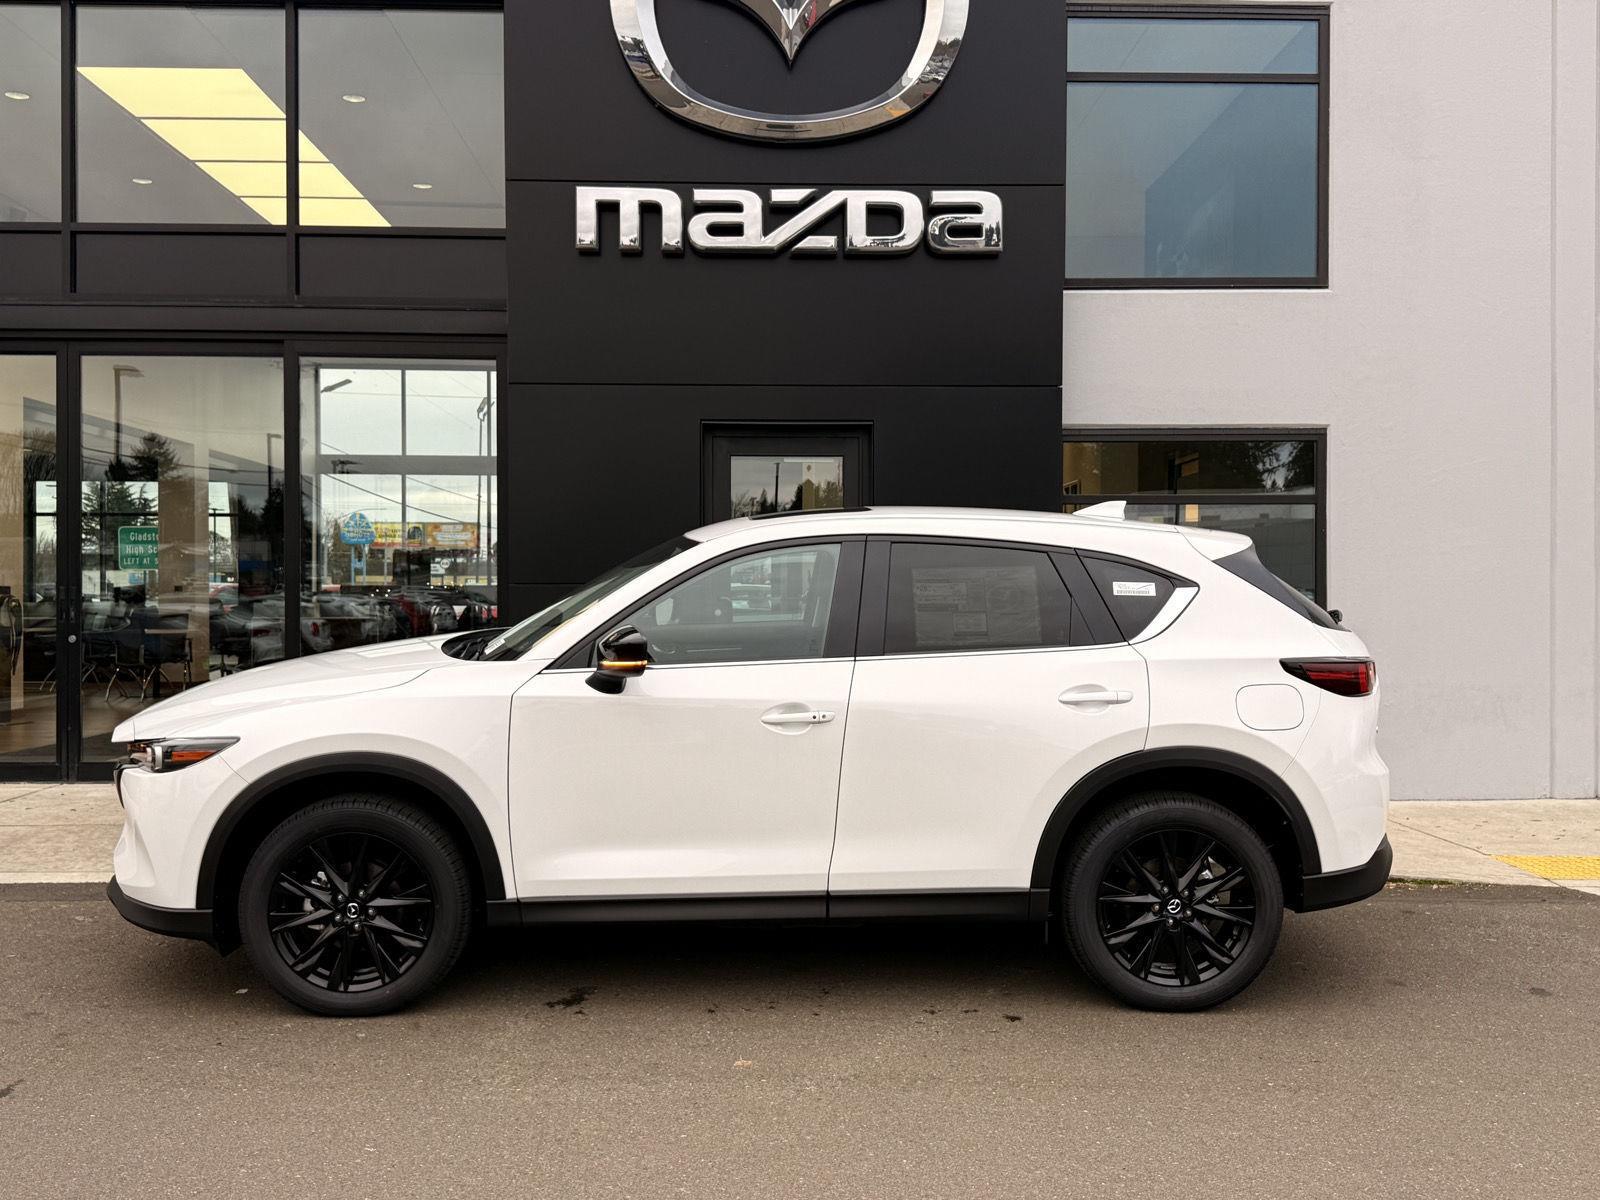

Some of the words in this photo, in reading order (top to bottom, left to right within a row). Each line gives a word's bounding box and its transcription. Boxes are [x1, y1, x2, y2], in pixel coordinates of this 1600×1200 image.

[126, 545, 144, 556] High
[123, 557, 139, 565] LEFT
[143, 557, 150, 565] AT
